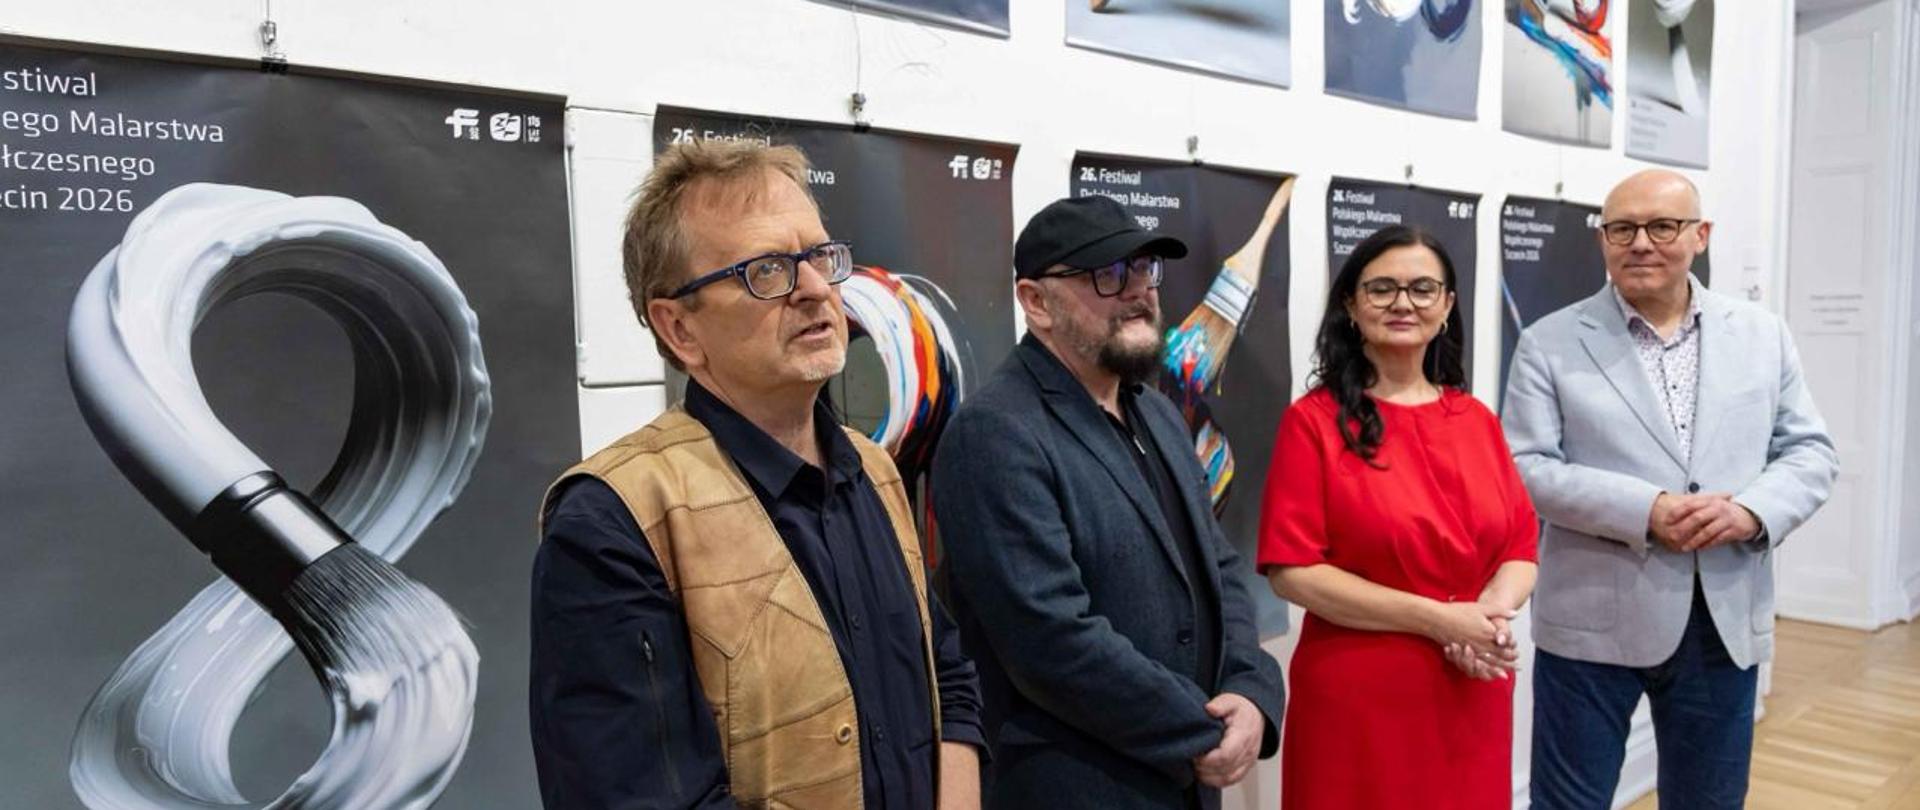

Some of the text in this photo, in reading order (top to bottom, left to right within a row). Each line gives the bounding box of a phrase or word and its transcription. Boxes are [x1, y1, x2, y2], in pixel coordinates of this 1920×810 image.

[3, 67, 97, 97] stiwal
[70, 110, 225, 143] Malarstwa
[1079, 166, 1142, 186] 26. Festiwal
[0, 184, 134, 213] cin 2026
[1130, 191, 1180, 209] Malarstwa
